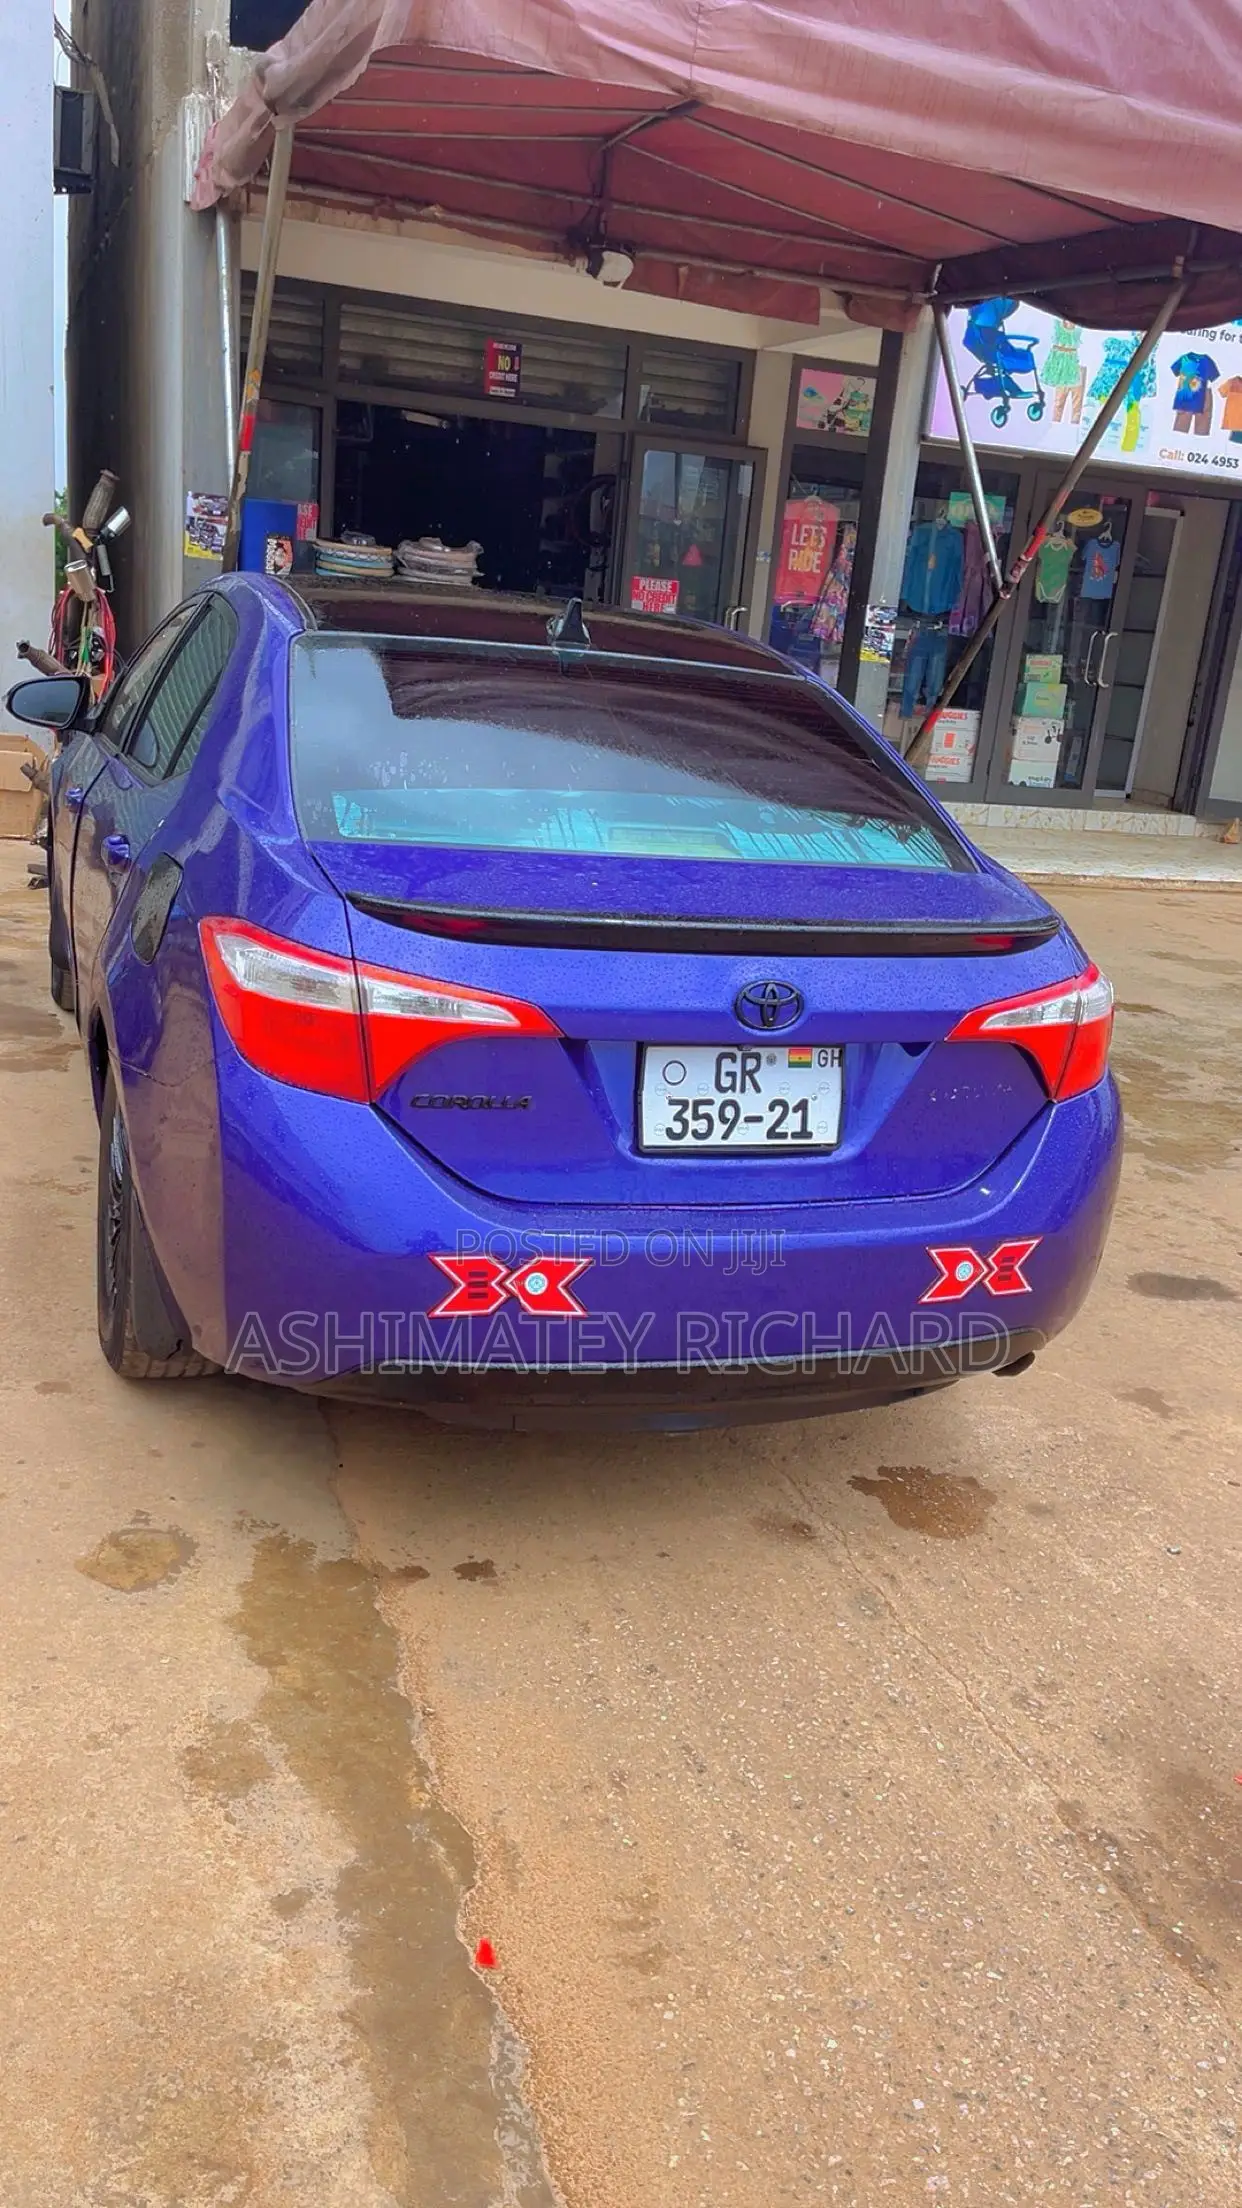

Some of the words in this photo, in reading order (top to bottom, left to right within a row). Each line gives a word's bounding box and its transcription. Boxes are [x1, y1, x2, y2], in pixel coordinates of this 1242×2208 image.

[1219, 329, 1236, 342] for
[497, 355, 511, 371] NO
[1159, 448, 1184, 461] Call:
[1187, 451, 1209, 464] 024
[1211, 455, 1240, 469] 4953
[788, 549, 823, 573] RIDE
[639, 577, 673, 592] PLEASE
[817, 1049, 842, 1068] GH
[714, 1051, 762, 1094] GR
[410, 1093, 533, 1109] COROLLA
[665, 1098, 814, 1141] 359-21
